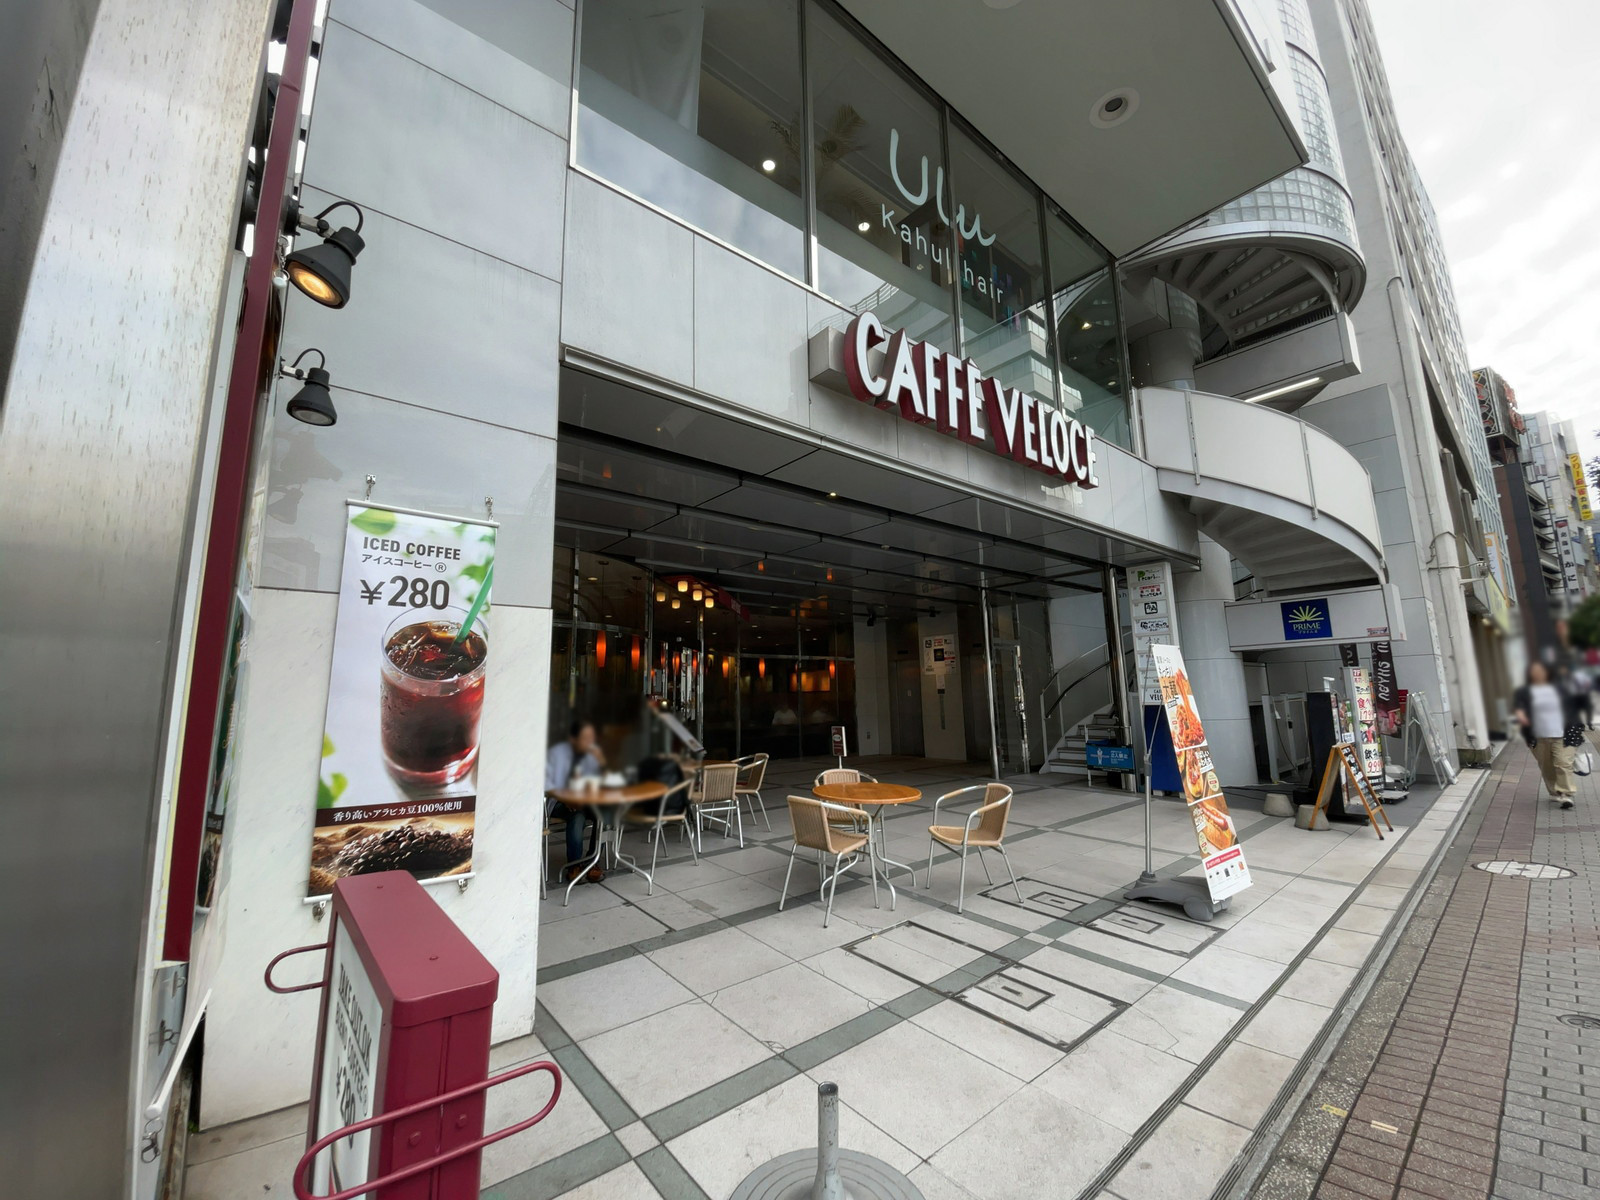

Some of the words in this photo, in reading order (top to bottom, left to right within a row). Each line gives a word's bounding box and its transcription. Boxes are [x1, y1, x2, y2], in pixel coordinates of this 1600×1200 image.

[889, 128, 997, 247] Ulu
[963, 260, 1004, 304] hair
[992, 376, 1099, 488] VELOCE
[361, 553, 432, 569] アイスコーヒー
[363, 536, 401, 553] ICED
[406, 542, 461, 560] COFFEE
[360, 575, 450, 611] ¥280
[1293, 622, 1321, 630] PRIME
[1378, 661, 1391, 701] SHABU
[333, 800, 463, 822] 香り高いアラビカ豆100%使用
[338, 963, 352, 1003] TAKE
[351, 994, 364, 1041] OUT
